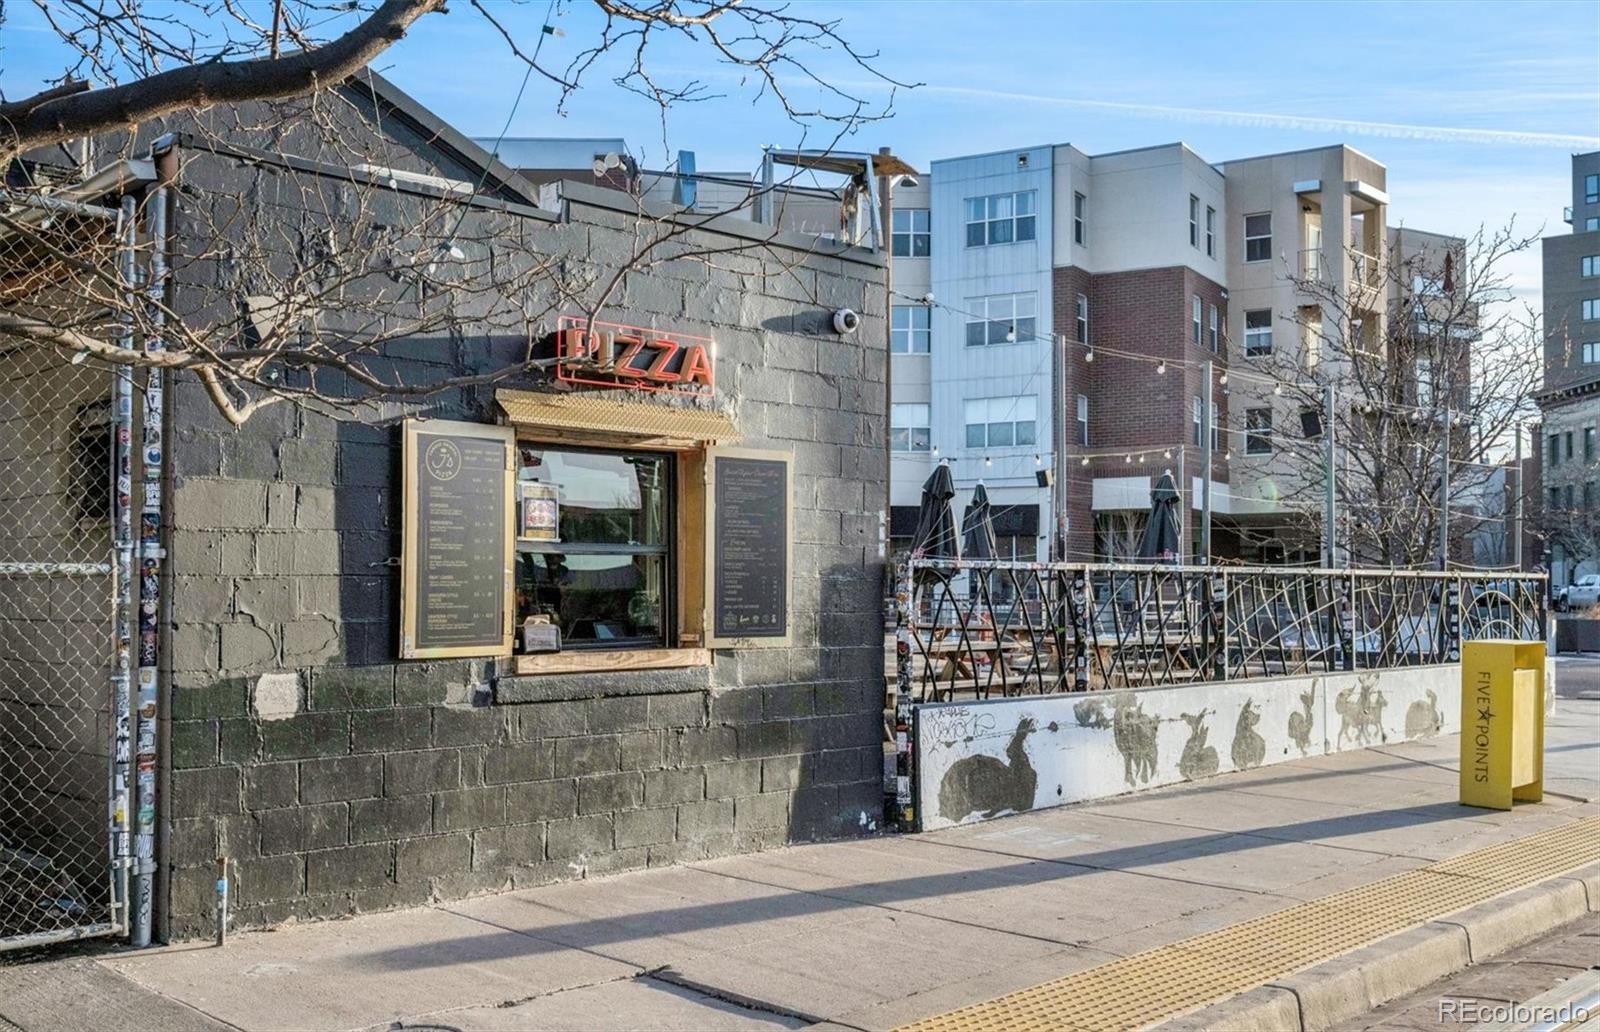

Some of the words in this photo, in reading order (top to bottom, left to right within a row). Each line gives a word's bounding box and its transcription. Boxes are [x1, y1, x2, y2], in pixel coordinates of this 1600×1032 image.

[566, 328, 713, 385] PIZZA
[1476, 672, 1490, 704] FIVE
[1475, 725, 1489, 783] POINTS
